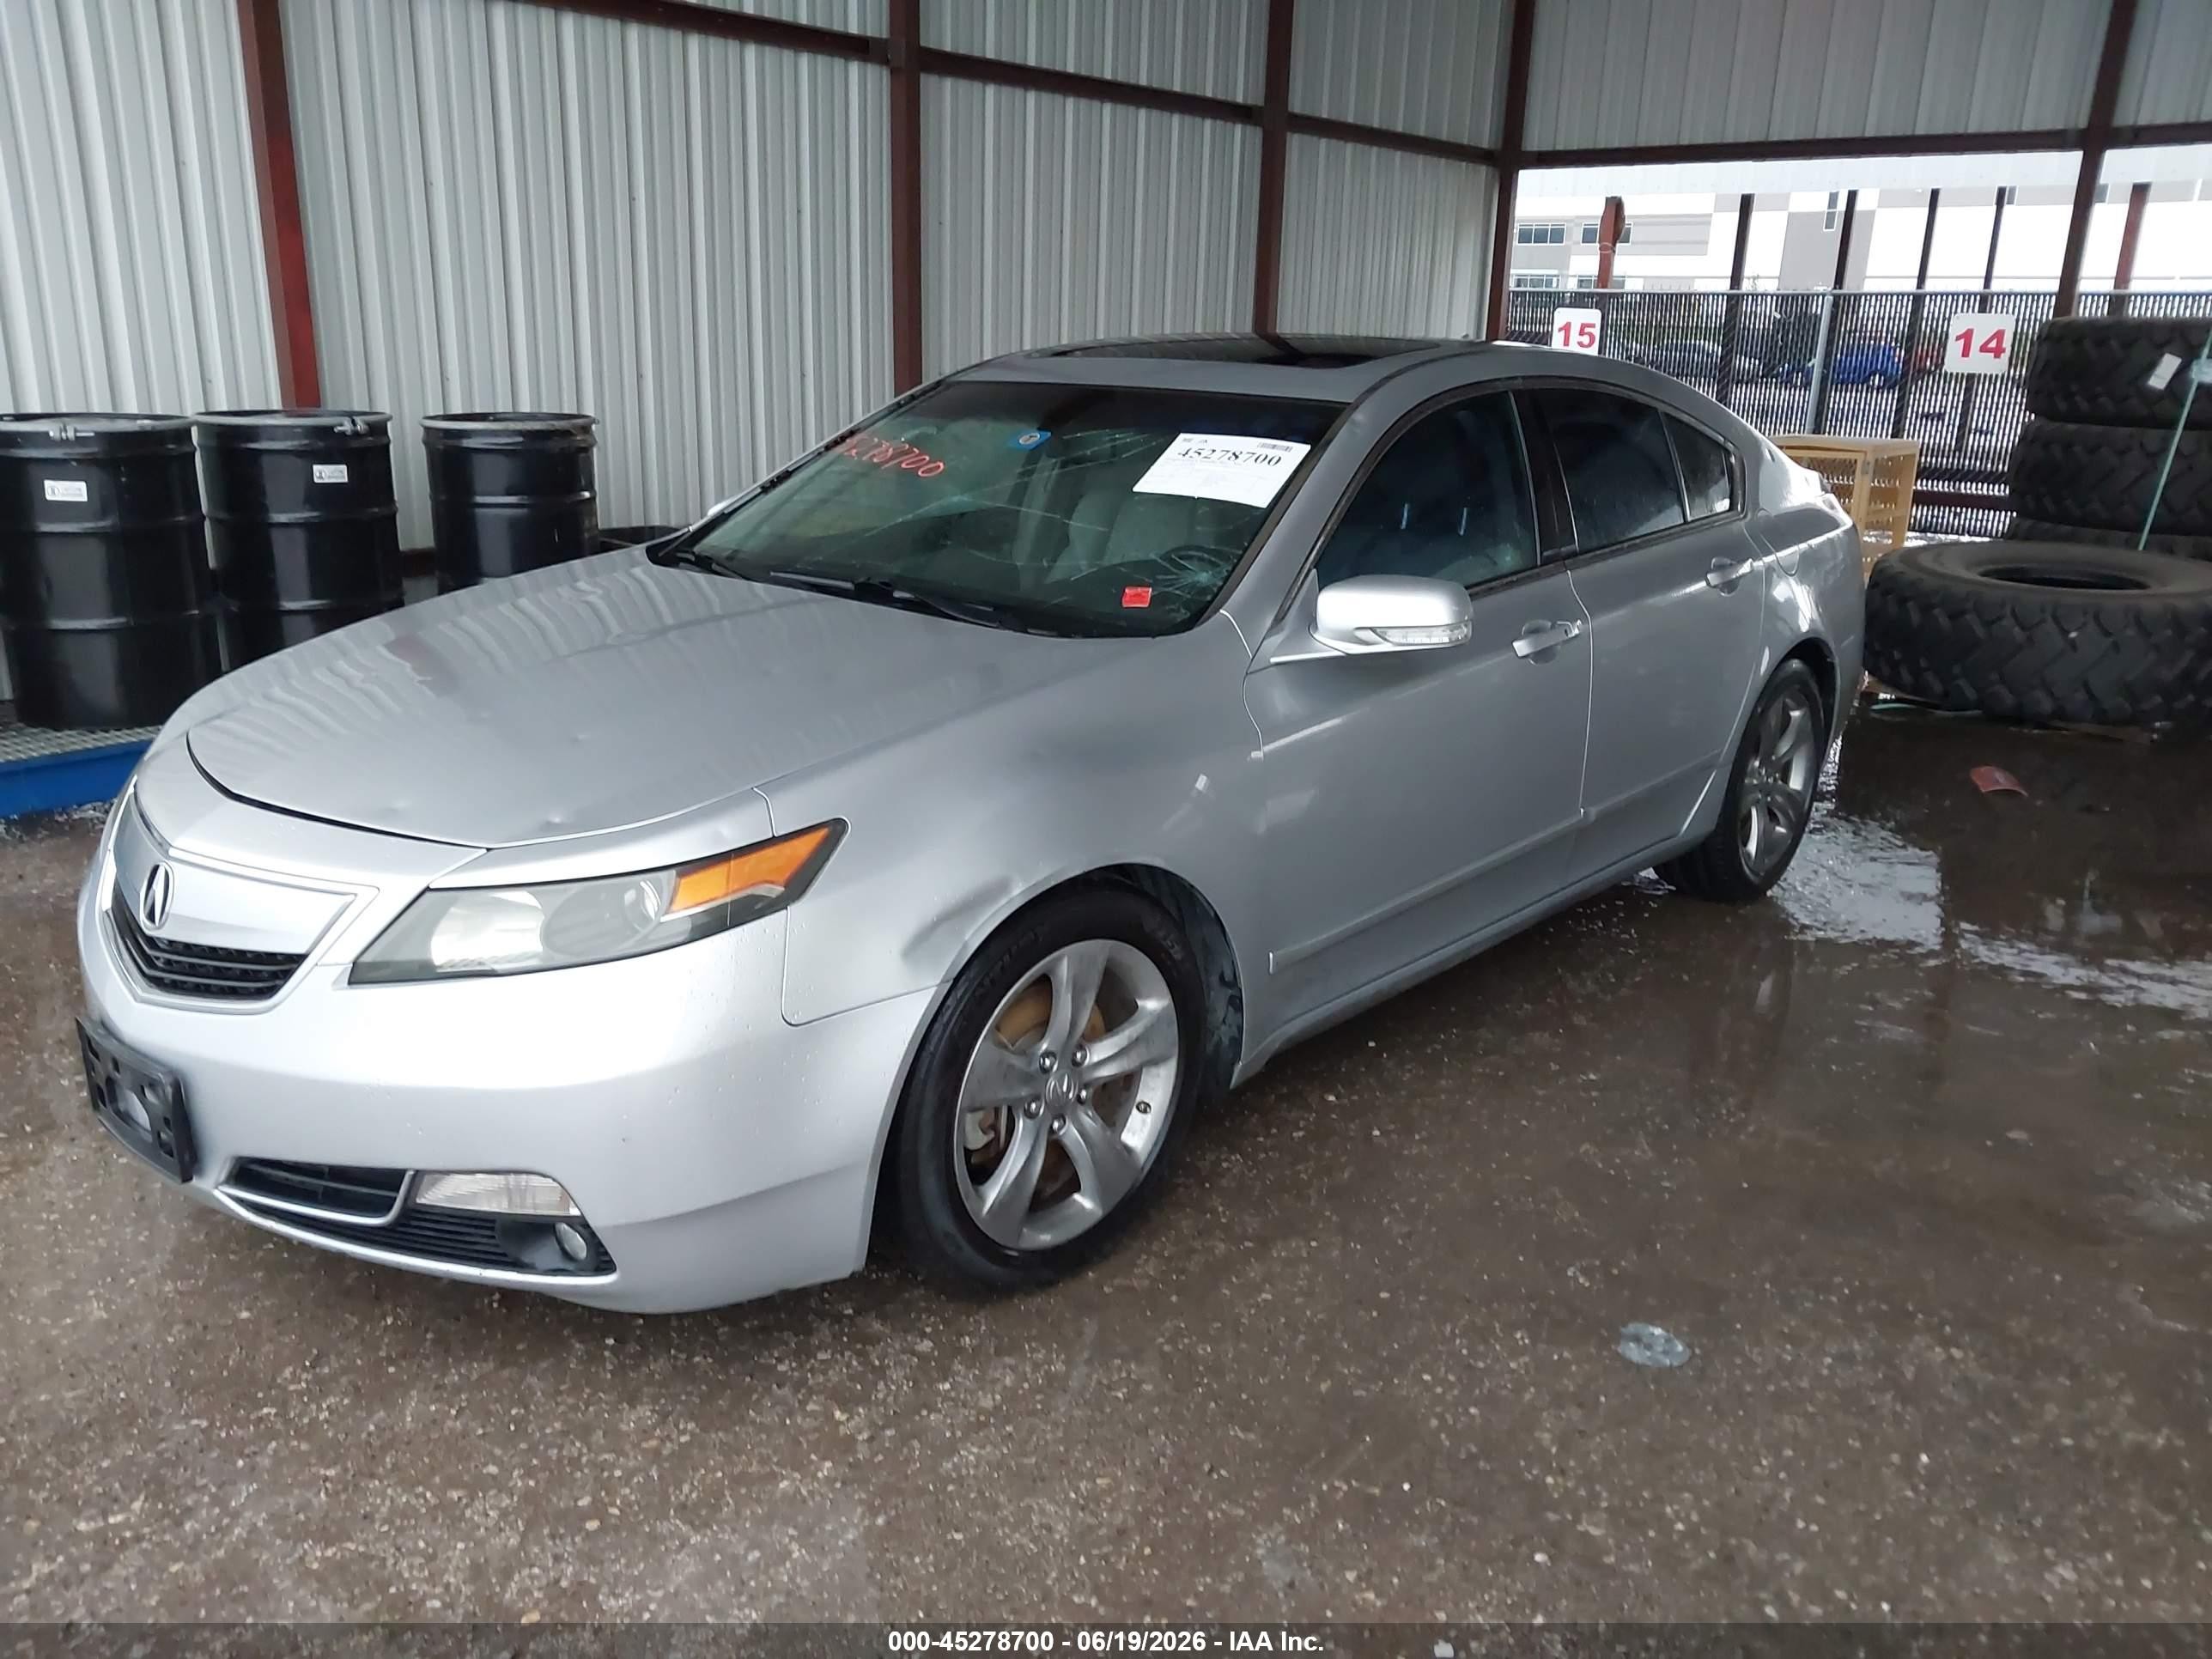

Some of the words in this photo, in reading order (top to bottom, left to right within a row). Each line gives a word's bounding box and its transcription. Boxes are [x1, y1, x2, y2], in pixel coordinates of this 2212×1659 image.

[1558, 321, 1596, 349] 15
[1954, 328, 2006, 359] 14
[1177, 447, 1283, 467] 45278700
